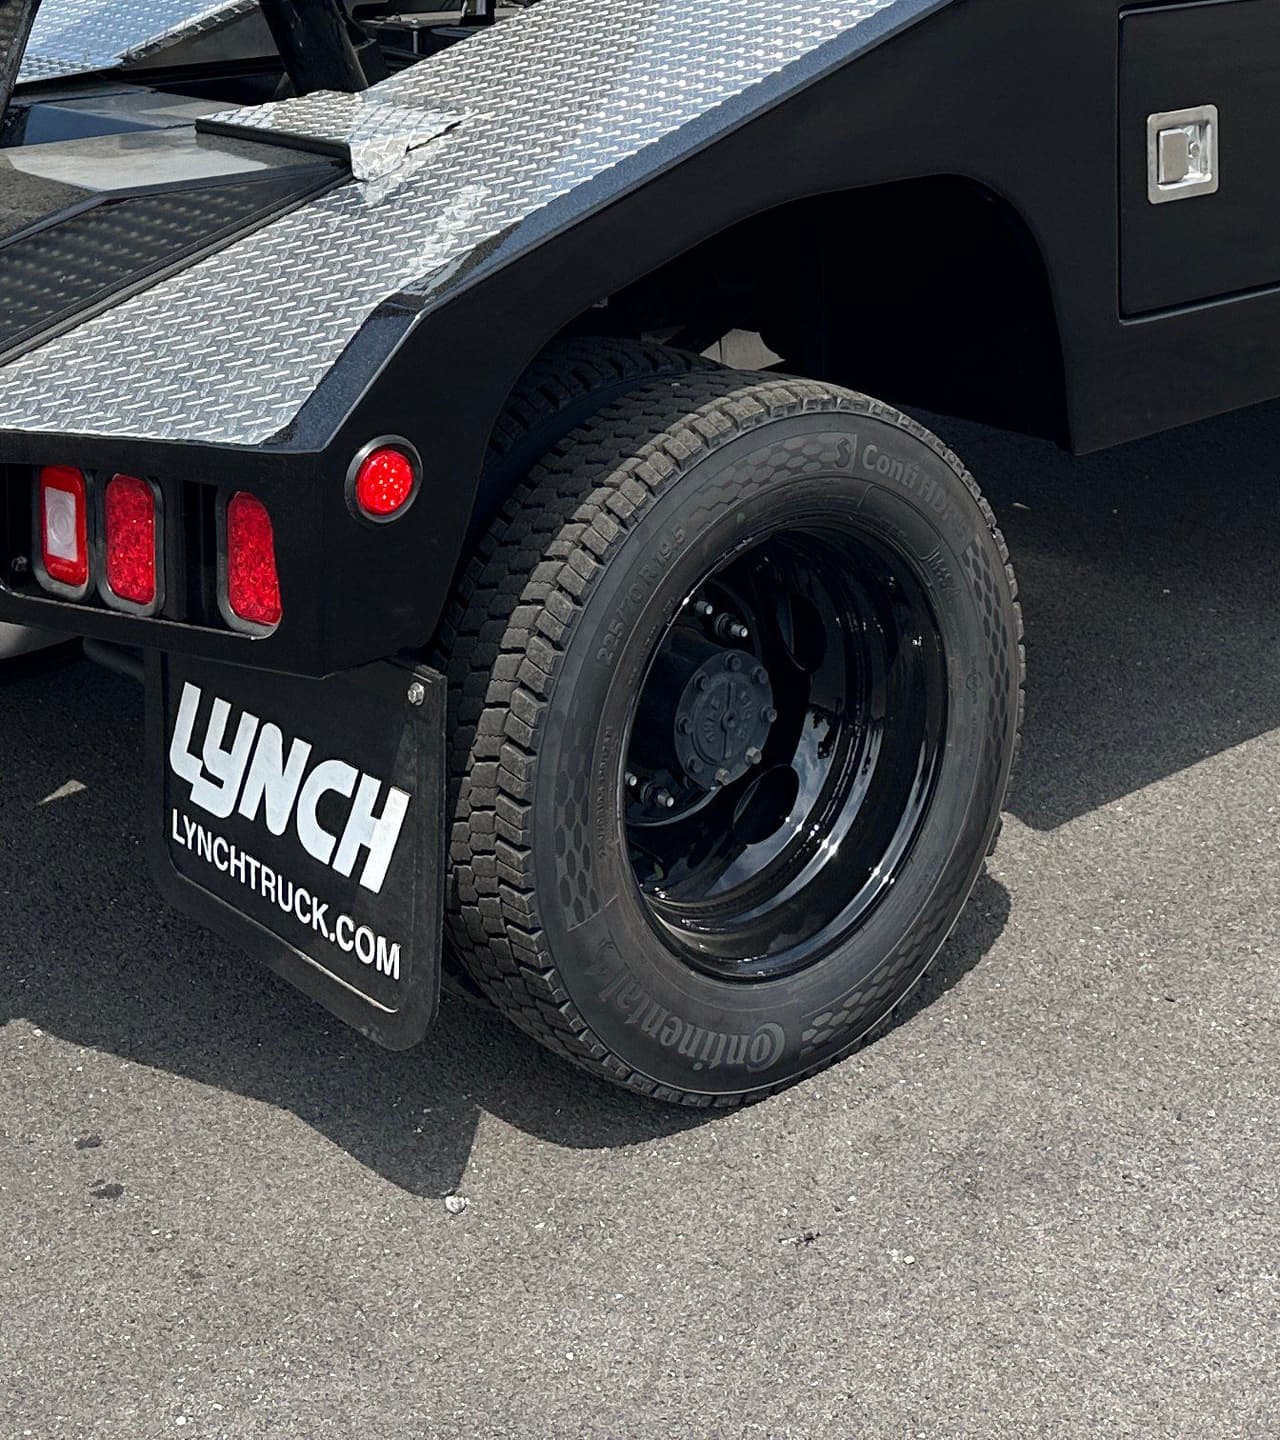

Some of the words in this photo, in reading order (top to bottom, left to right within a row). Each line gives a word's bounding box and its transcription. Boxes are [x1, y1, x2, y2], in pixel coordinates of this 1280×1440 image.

[170, 681, 412, 895] LYNCH
[172, 808, 401, 980] LYNCHTRUCK.COM
[597, 974, 786, 1072] Continental
